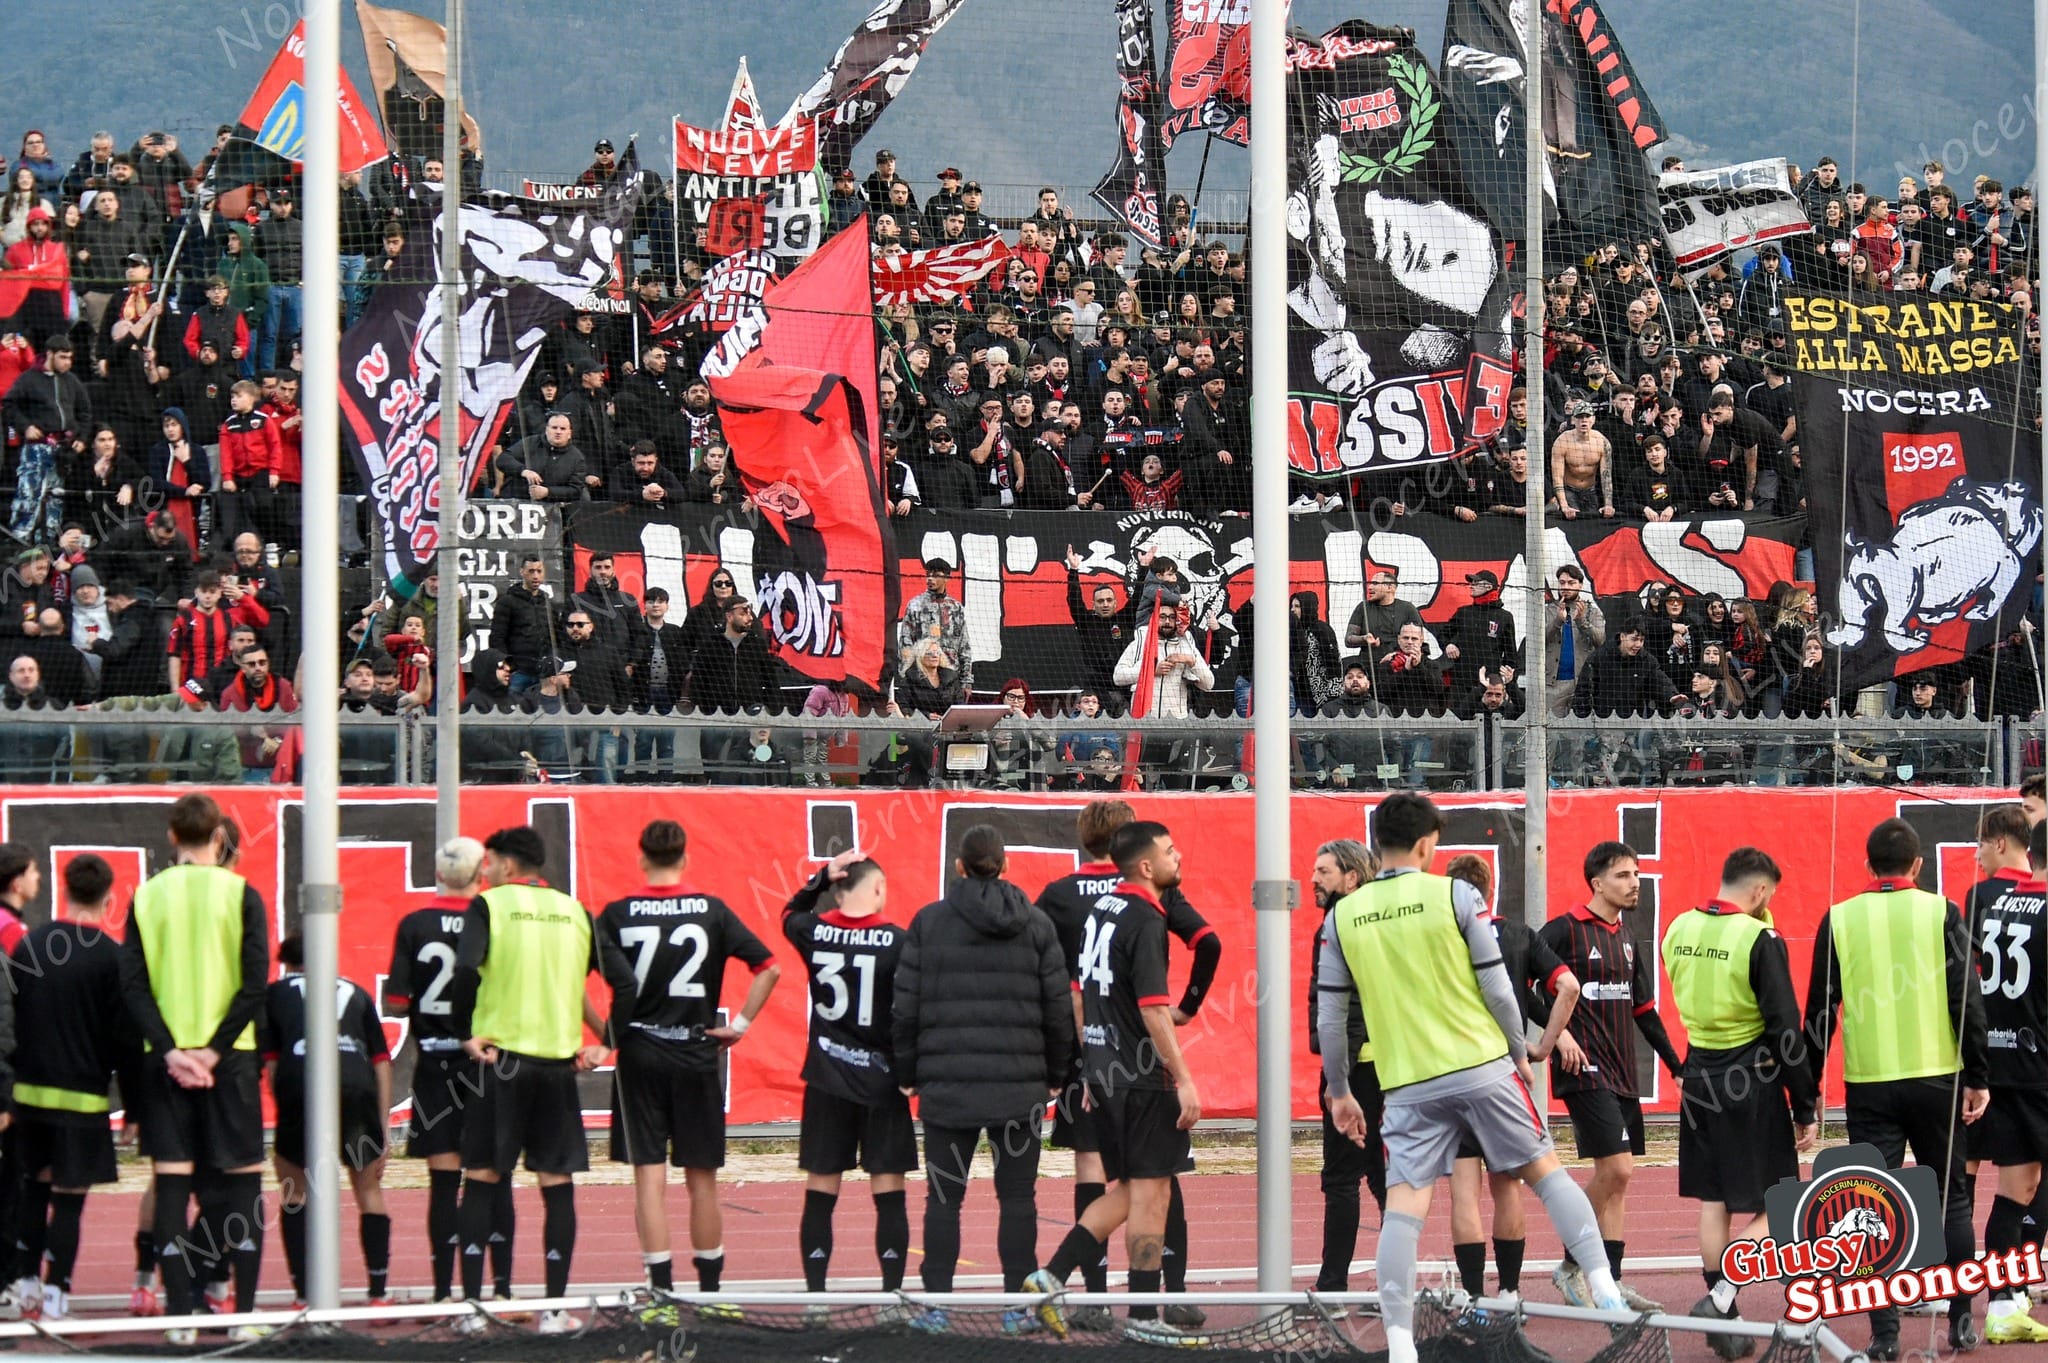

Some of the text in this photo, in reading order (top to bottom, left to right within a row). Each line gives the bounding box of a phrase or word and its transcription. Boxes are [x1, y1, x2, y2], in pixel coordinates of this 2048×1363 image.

[687, 126, 806, 155] NUOVE
[703, 150, 794, 175] LEVE
[1796, 336, 2021, 375] ALLA MASSA
[1837, 386, 1992, 416] NOCERA
[1890, 442, 1957, 473] 1992
[629, 897, 709, 917] PADALINO
[813, 923, 894, 947] BOTTALICO
[619, 922, 710, 998] 72
[1979, 918, 2032, 1000] 33
[811, 950, 877, 1027] 31
